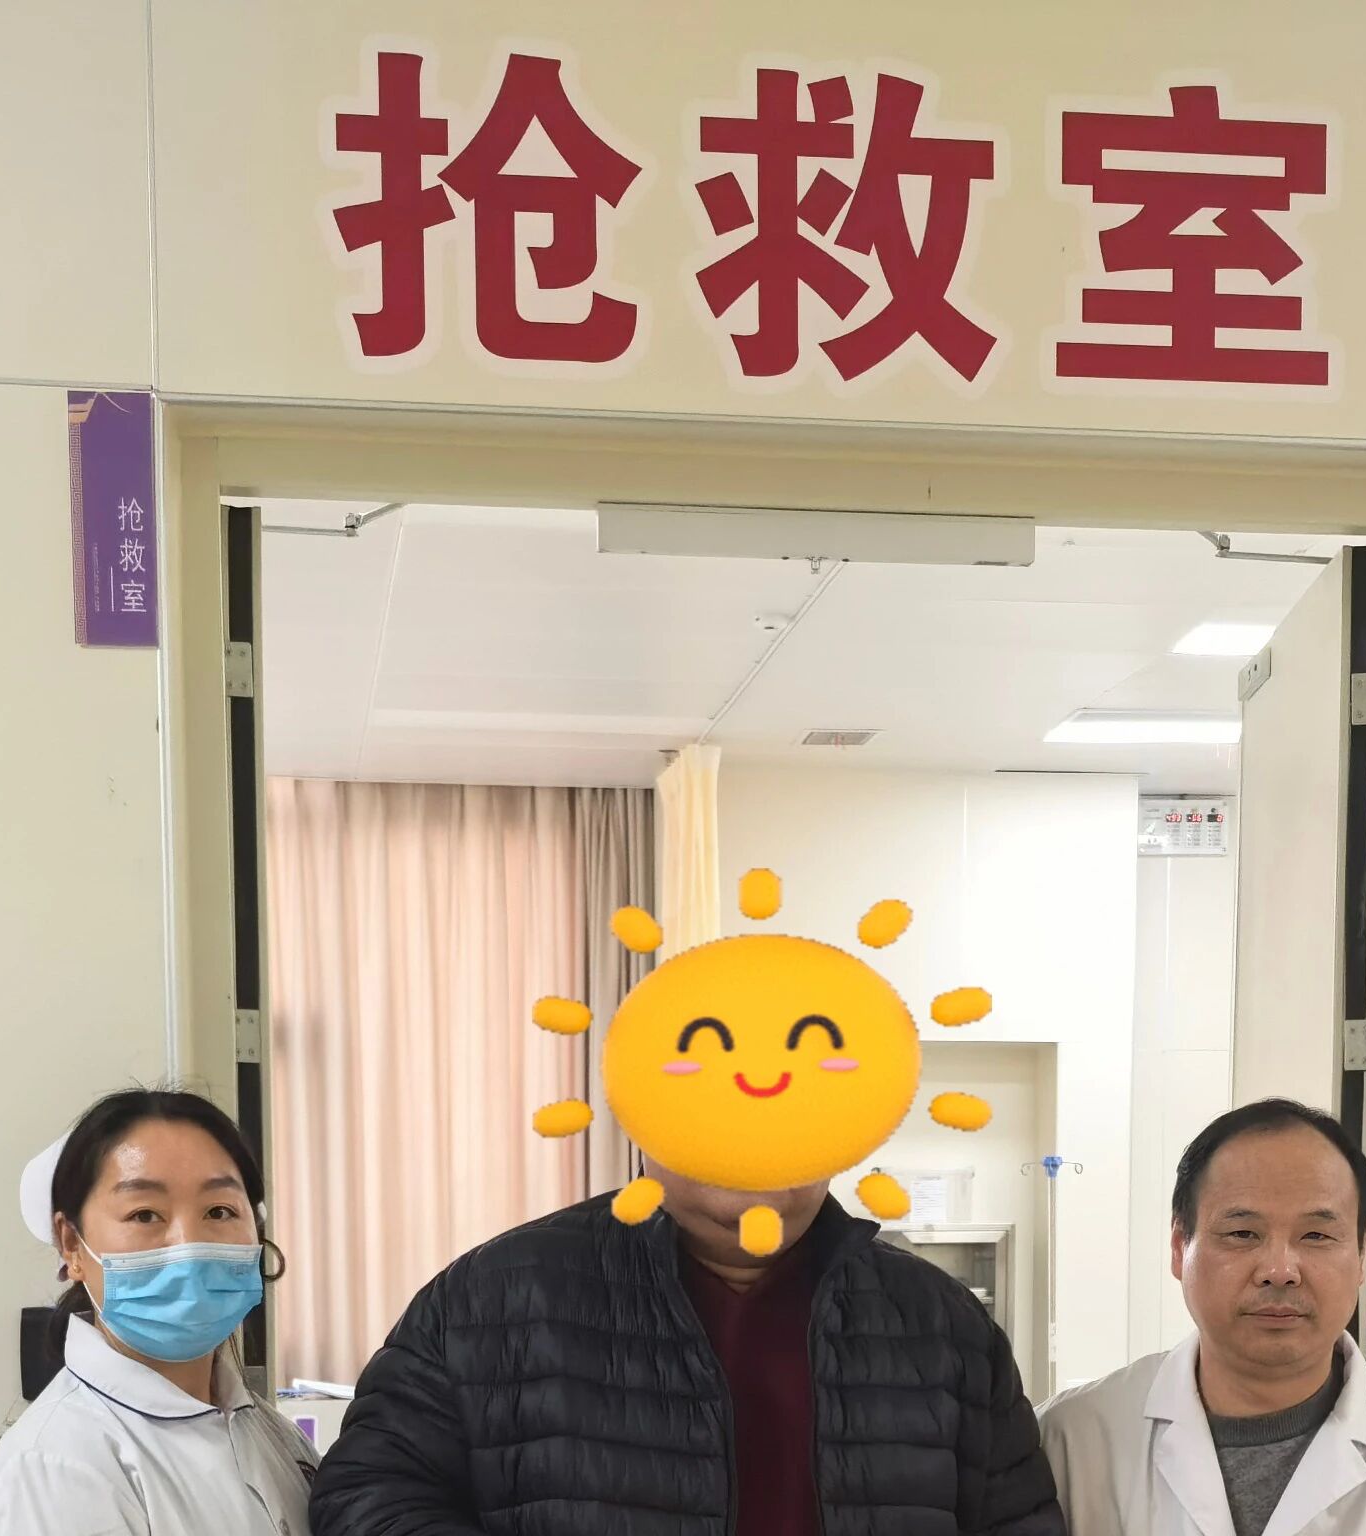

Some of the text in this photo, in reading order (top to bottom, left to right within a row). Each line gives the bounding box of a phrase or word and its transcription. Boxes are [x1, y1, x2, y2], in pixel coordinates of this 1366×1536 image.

[334, 52, 1328, 385] 抢救室
[117, 496, 147, 613] 抢救室
